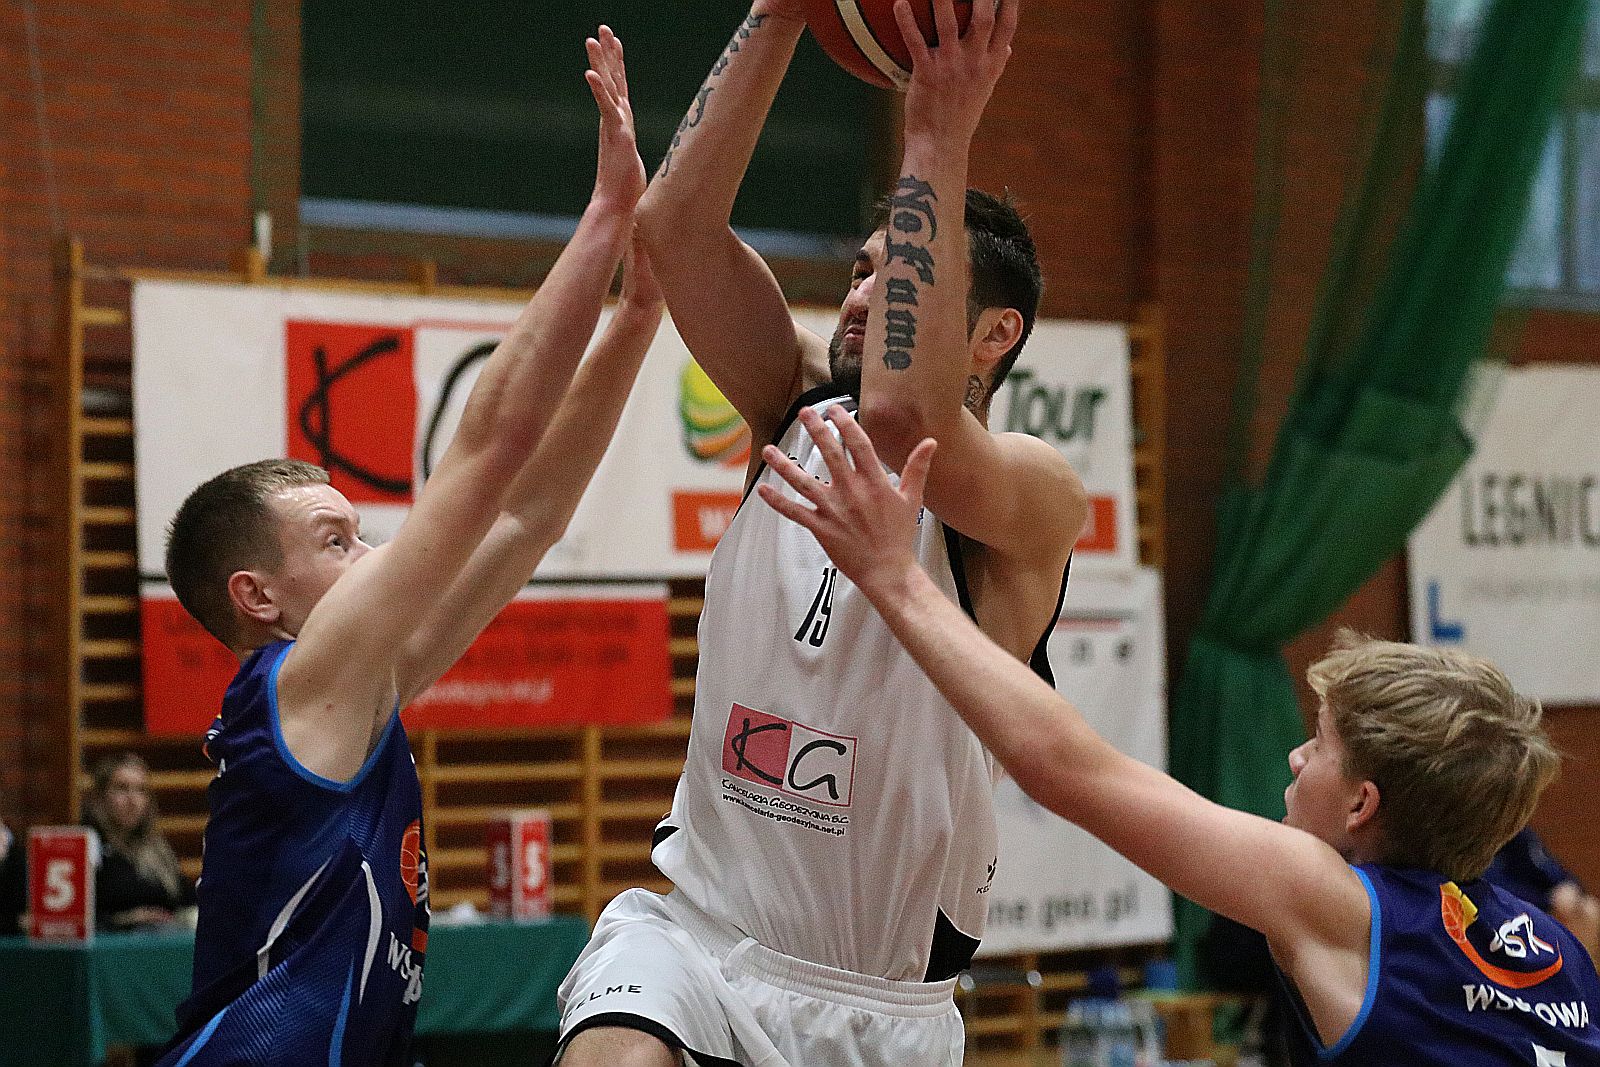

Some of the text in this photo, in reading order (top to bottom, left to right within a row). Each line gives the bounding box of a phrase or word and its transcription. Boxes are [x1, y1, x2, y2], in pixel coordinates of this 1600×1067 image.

[794, 567, 837, 647] 19
[42, 858, 75, 911] 5
[1463, 984, 1590, 1028] WSOWA
